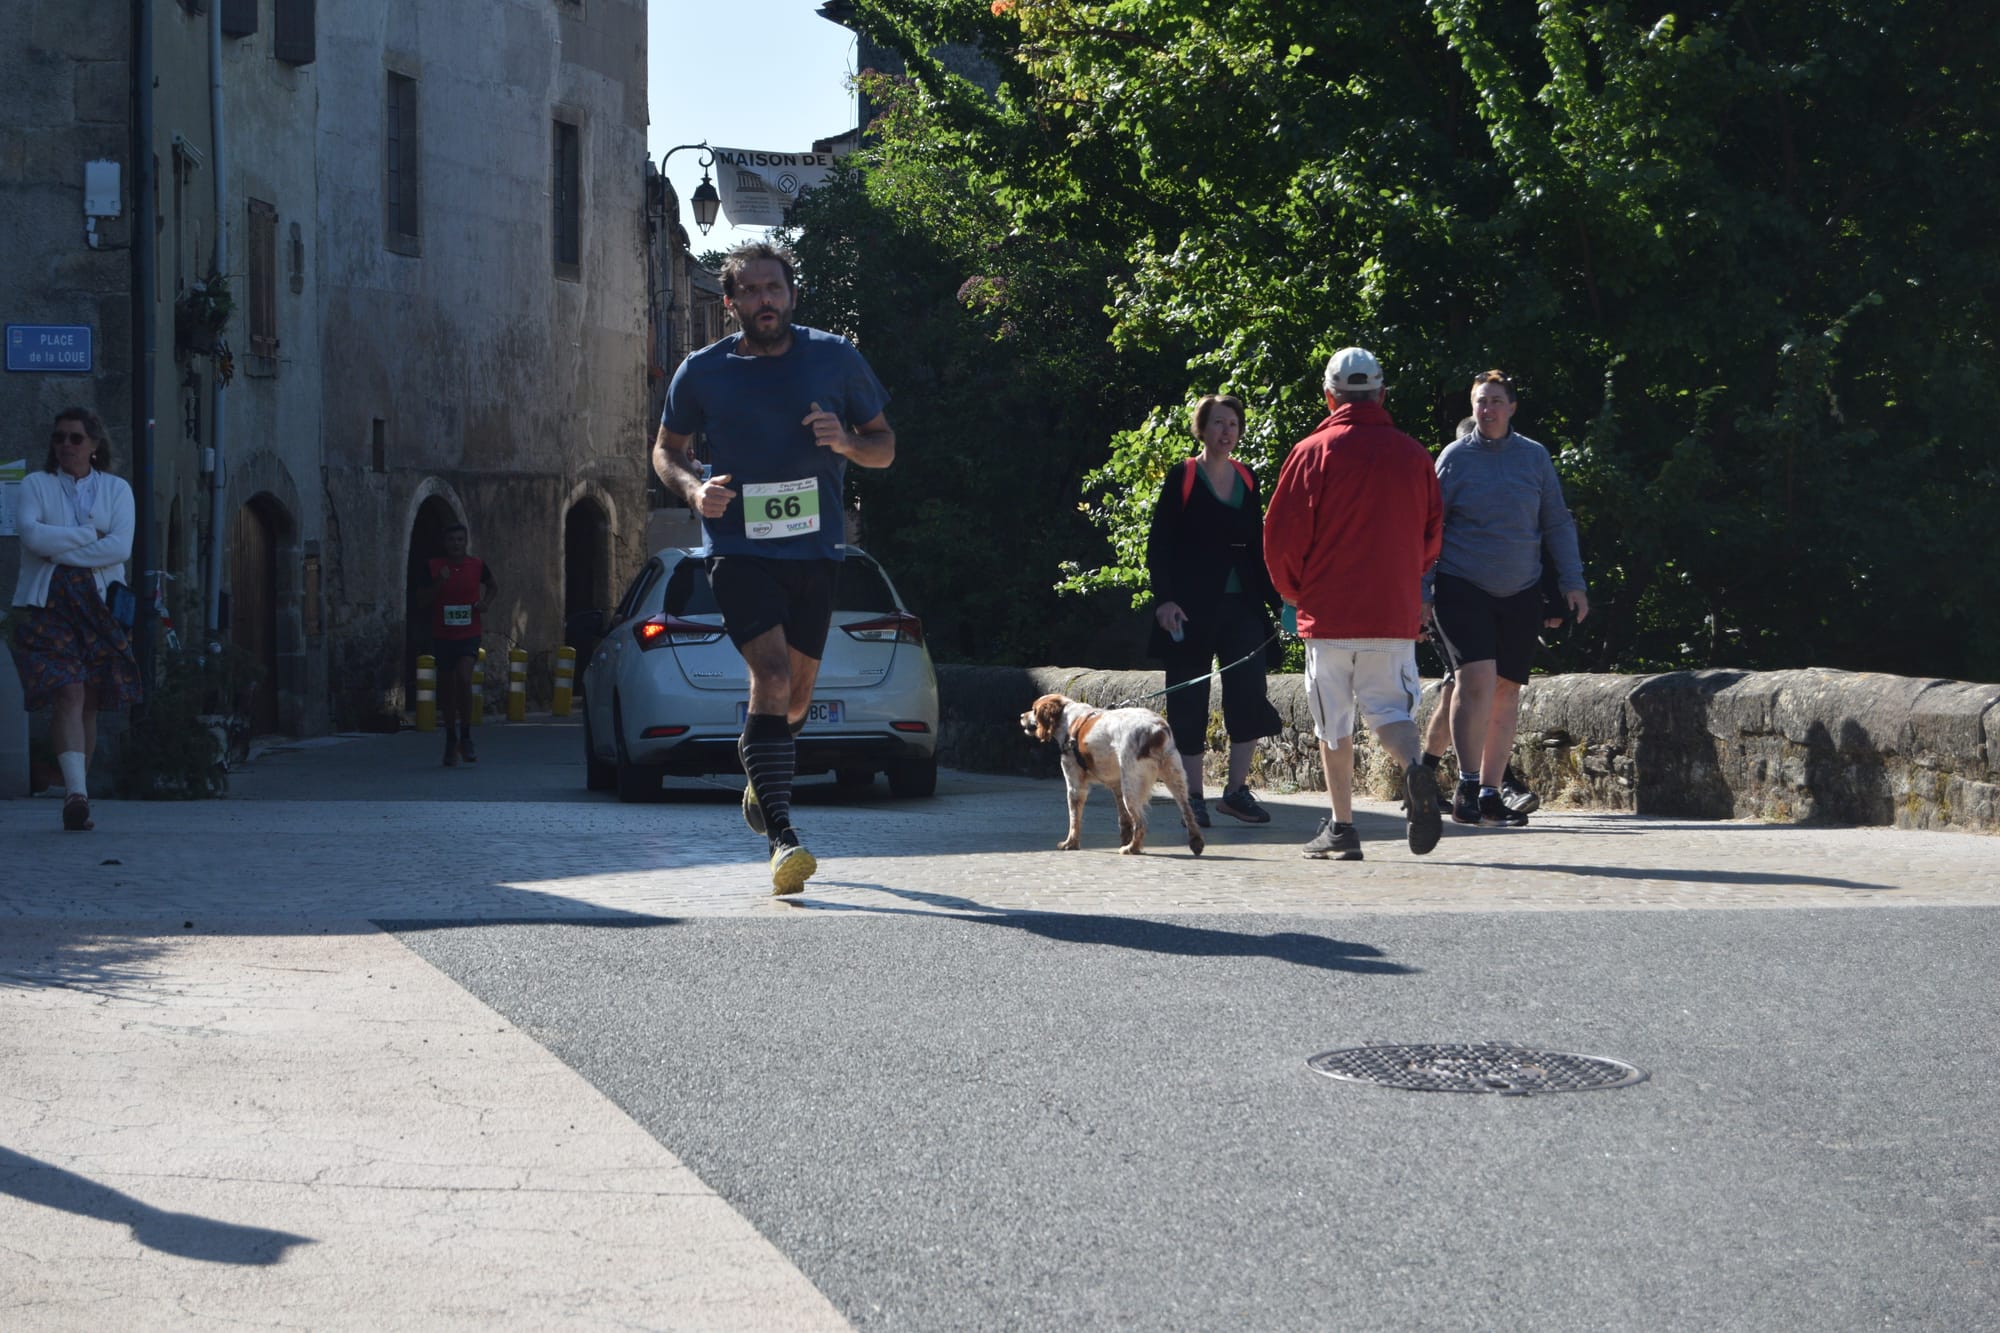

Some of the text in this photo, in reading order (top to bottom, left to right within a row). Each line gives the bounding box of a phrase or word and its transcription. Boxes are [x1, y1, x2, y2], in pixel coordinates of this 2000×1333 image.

[720, 152, 797, 166] MAISON
[803, 155, 827, 166] DE
[40, 333, 74, 346] PLACE
[30, 351, 86, 363] de la LOUE
[765, 496, 800, 519] 66
[448, 610, 468, 619] 152
[810, 704, 828, 720] BC
